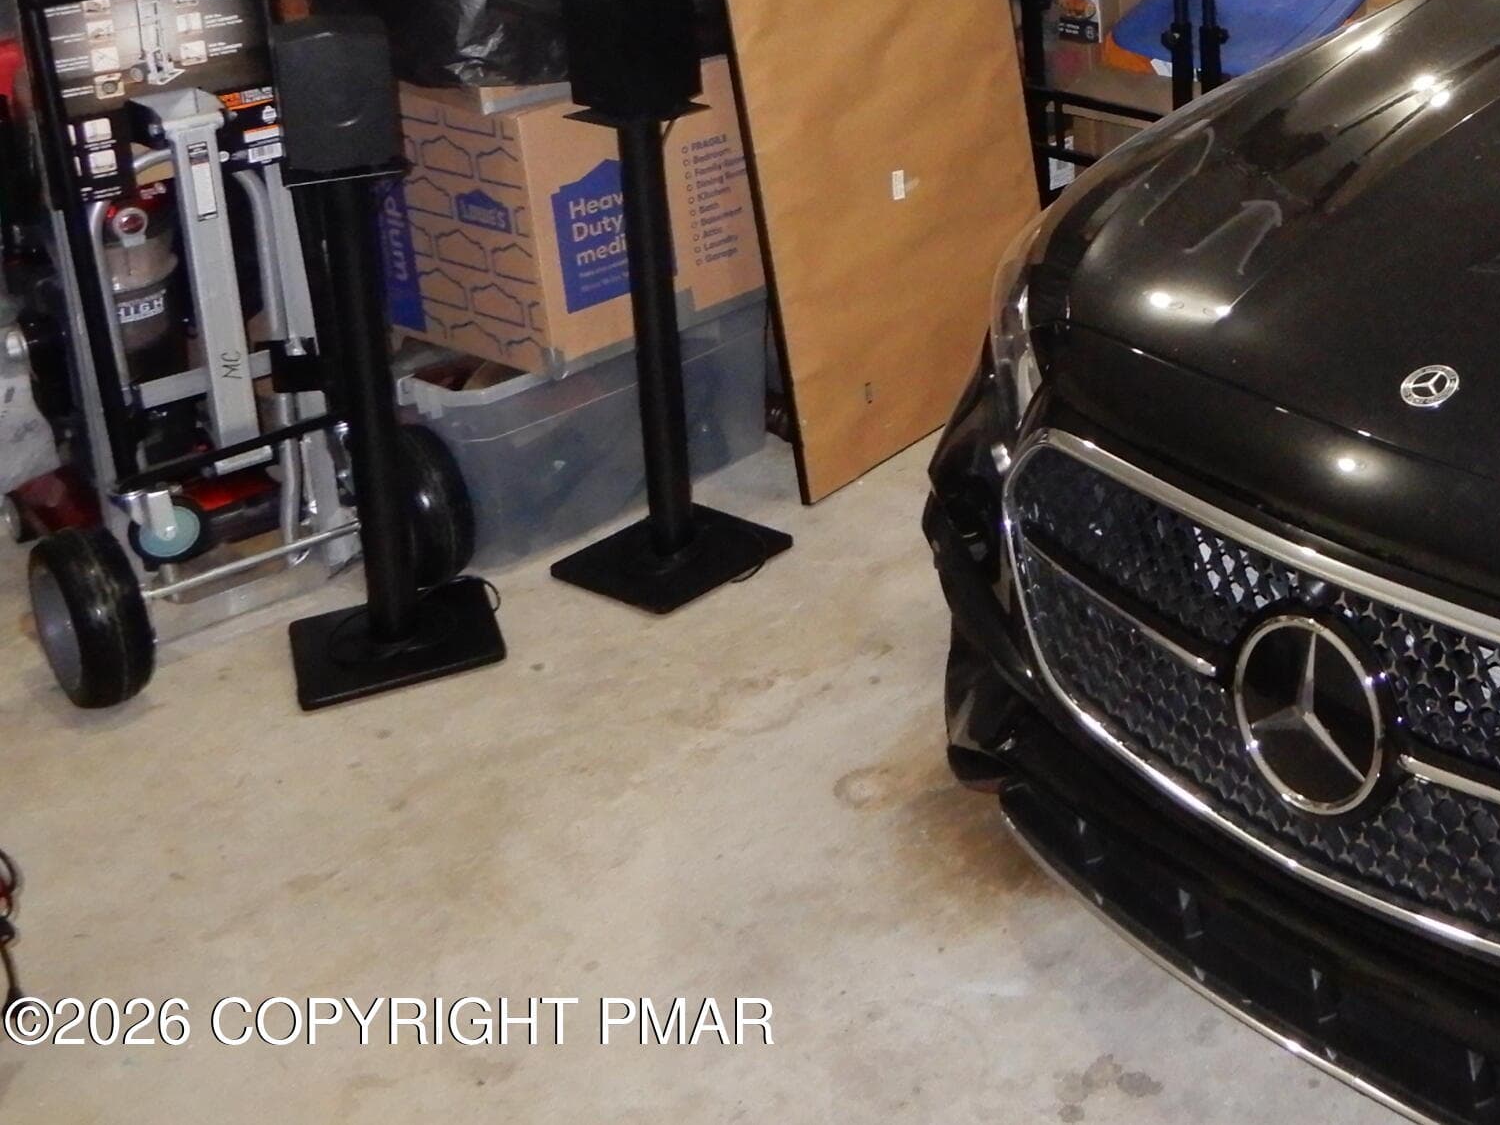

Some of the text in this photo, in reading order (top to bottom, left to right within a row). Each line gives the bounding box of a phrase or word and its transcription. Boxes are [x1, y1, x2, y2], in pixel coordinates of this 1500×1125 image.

[569, 192, 624, 220] Heav
[572, 213, 625, 242] Duty
[576, 234, 628, 266] medi
